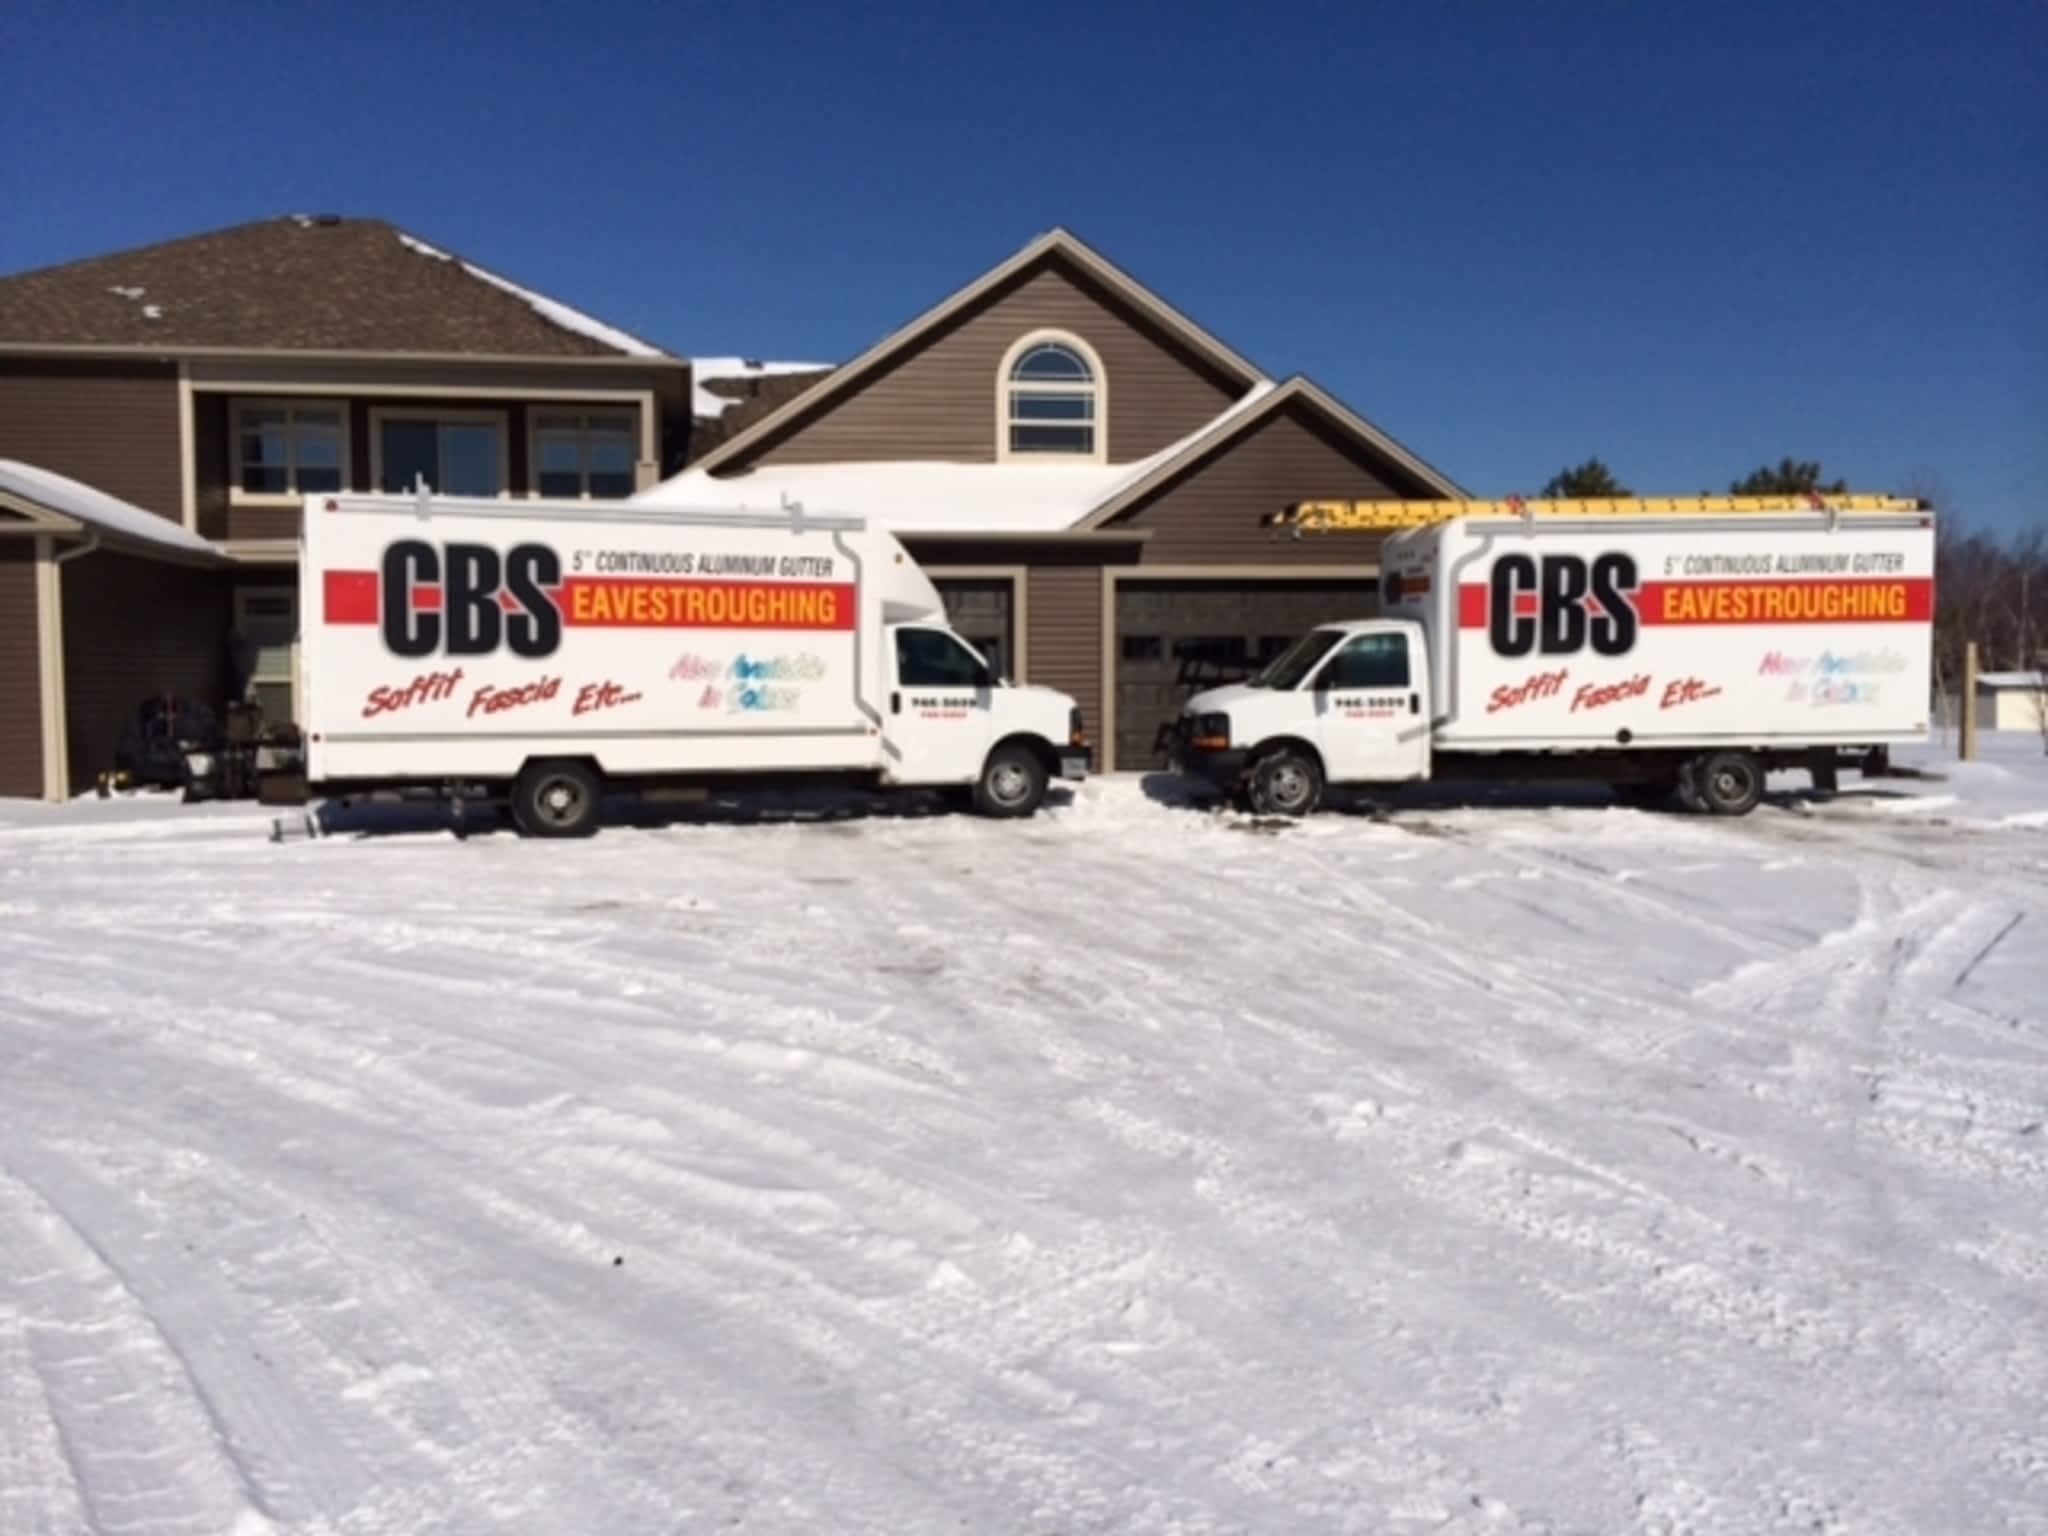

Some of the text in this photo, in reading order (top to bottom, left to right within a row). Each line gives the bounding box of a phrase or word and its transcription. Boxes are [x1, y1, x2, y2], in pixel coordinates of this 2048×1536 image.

[597, 551, 694, 573] CONTINUOUS
[697, 555, 776, 576] ALUMINUM
[779, 557, 835, 577] GUTTER
[1683, 554, 1773, 575] CONTINUOUS
[1775, 554, 1850, 574] ALUMINUM
[1852, 553, 1905, 573] GUTTER
[381, 539, 562, 659] CBS
[572, 585, 837, 623] EAVESTROUGHING
[1490, 552, 1638, 656] CBS
[1663, 585, 1906, 620] EAVESTROUGHING
[362, 667, 463, 718] Soffit
[466, 675, 563, 718] Fascia
[1486, 668, 1568, 713] Soffit
[1570, 674, 1652, 713] Fascia
